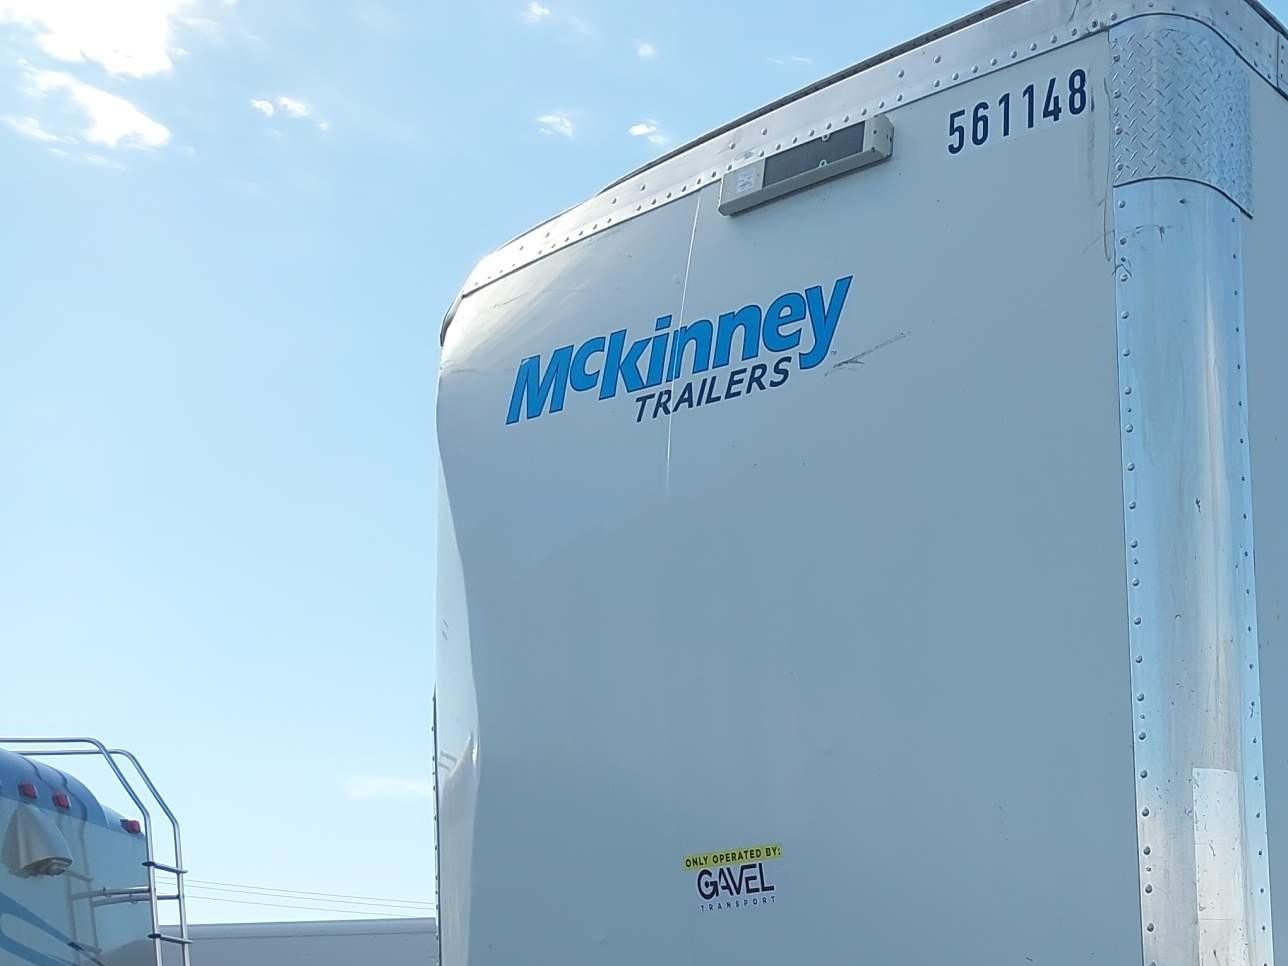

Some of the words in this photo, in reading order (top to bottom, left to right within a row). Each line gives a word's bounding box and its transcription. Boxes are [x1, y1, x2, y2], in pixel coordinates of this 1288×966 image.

[947, 68, 1088, 155] 561148
[635, 356, 792, 422] TRAILERS
[685, 855, 709, 868] ONLY
[712, 848, 761, 864] OPERATED
[765, 846, 781, 857] BY:
[697, 862, 775, 900] GAVEL
[700, 895, 776, 912] TRANSPORT
